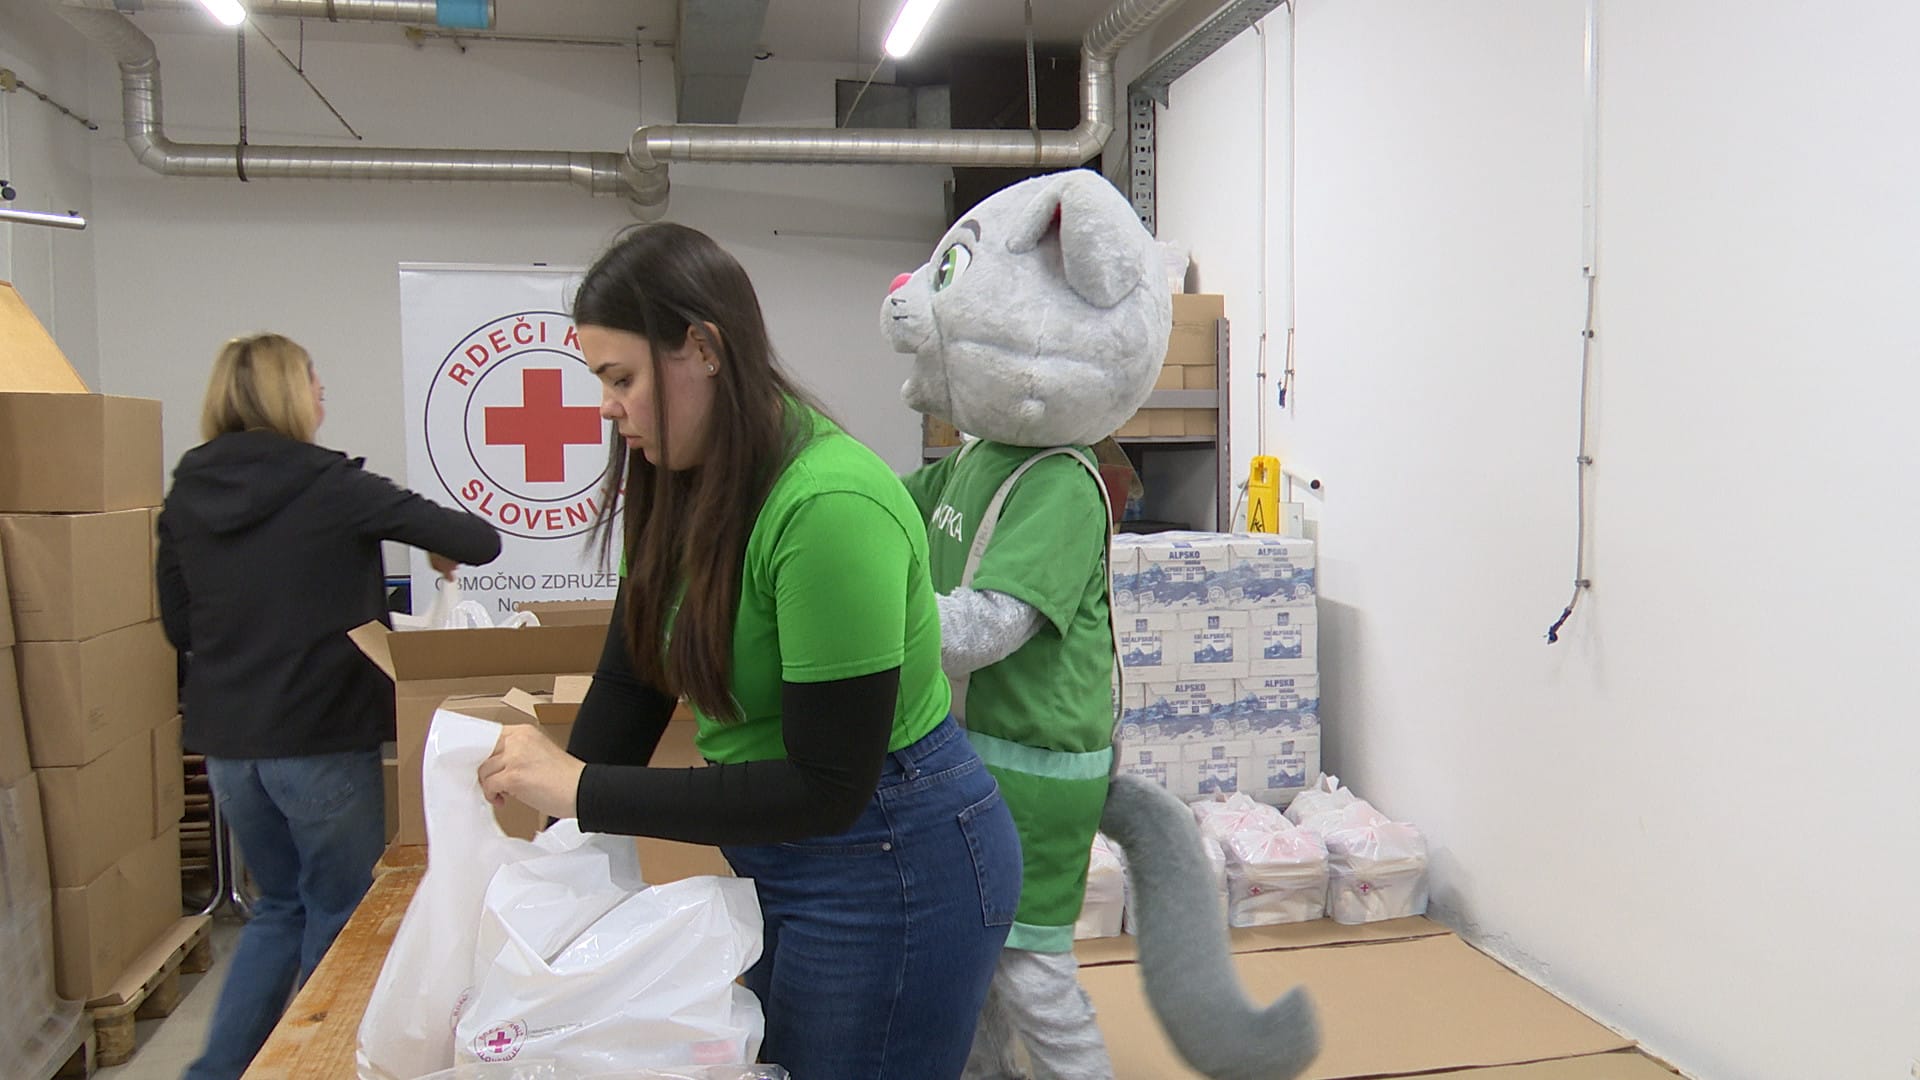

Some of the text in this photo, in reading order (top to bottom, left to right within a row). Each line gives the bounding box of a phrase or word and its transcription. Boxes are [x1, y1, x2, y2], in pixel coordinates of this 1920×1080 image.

[448, 316, 581, 386] RDEČI K
[462, 478, 627, 532] SLOVENI
[1168, 551, 1201, 560] ALPSKO
[1257, 548, 1289, 556] ALPSKO
[541, 570, 617, 589] ZDRUŽE
[1175, 683, 1206, 692] ALPSKO
[1264, 679, 1295, 688] ALPSKO
